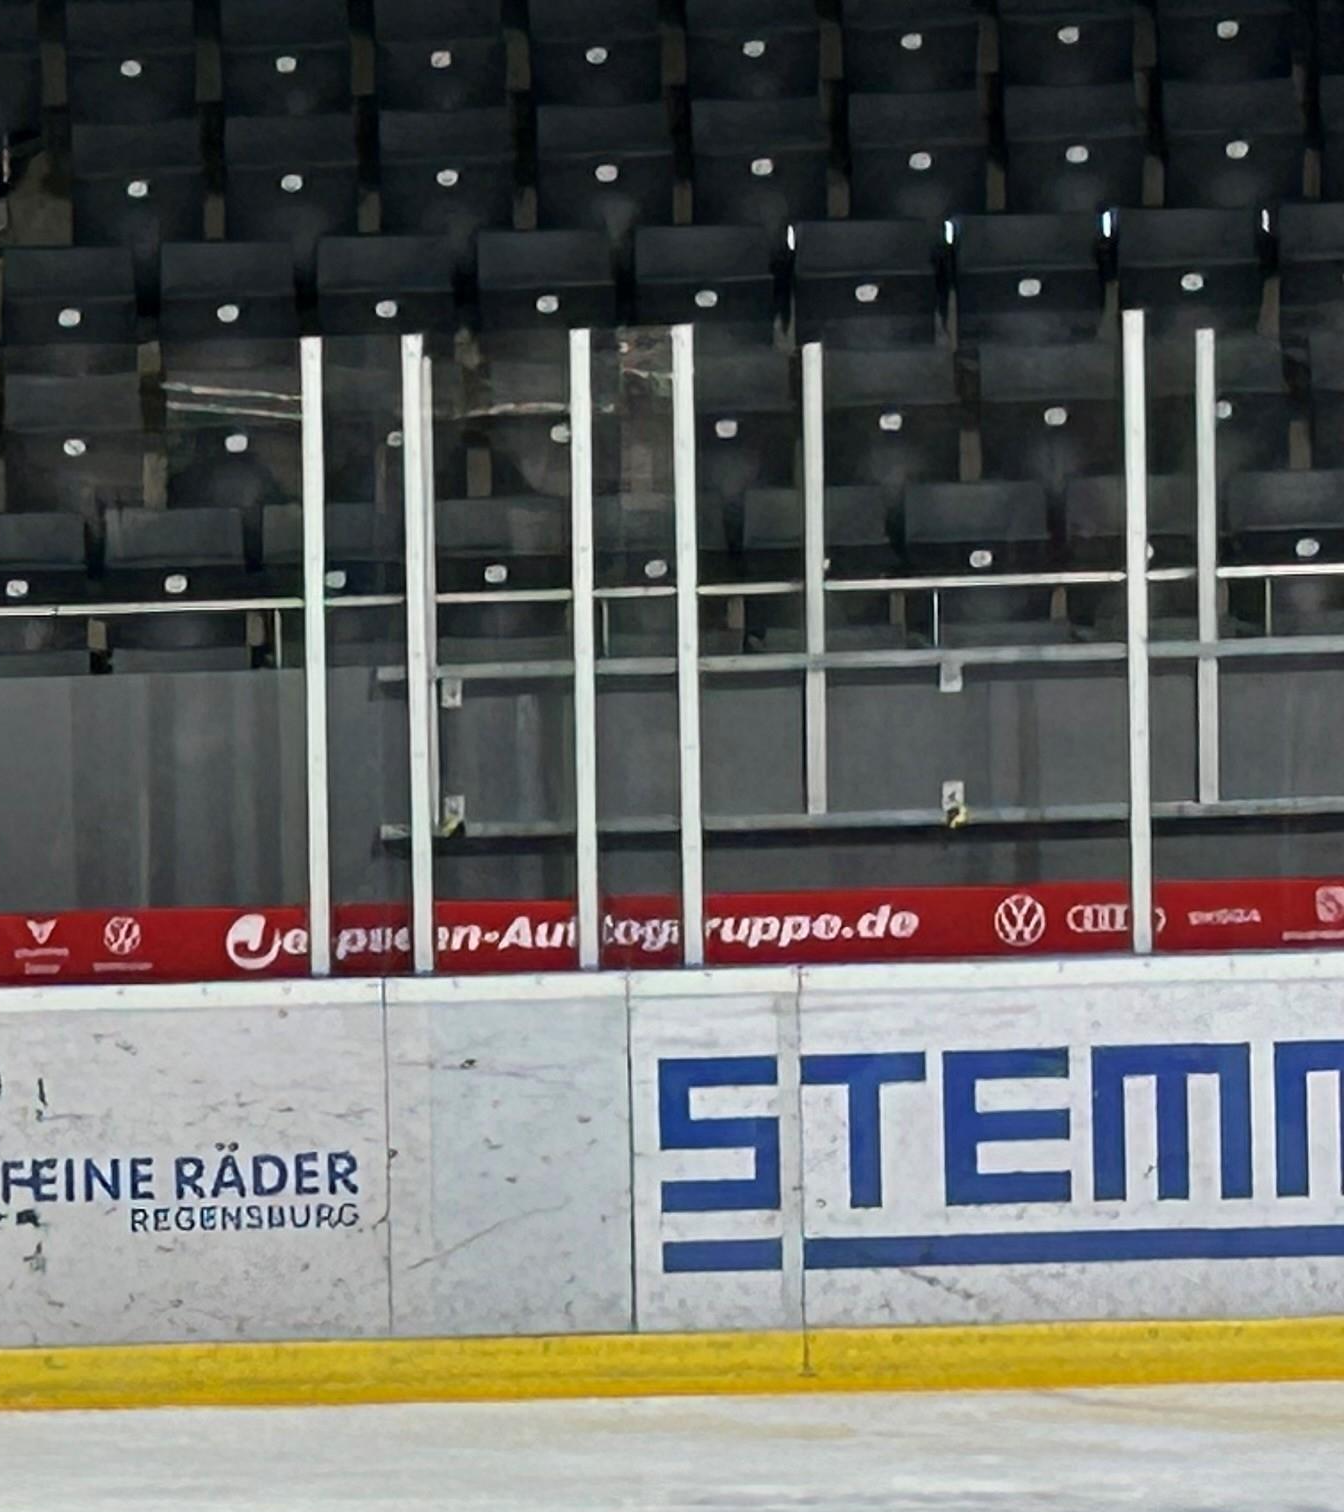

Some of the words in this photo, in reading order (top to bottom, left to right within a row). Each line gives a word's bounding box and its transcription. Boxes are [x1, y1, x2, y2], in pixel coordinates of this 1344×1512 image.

[0, 1156, 155, 1204] FEINE
[174, 1141, 360, 1200] RÄDER
[130, 1202, 360, 1233] REGENSBURG
